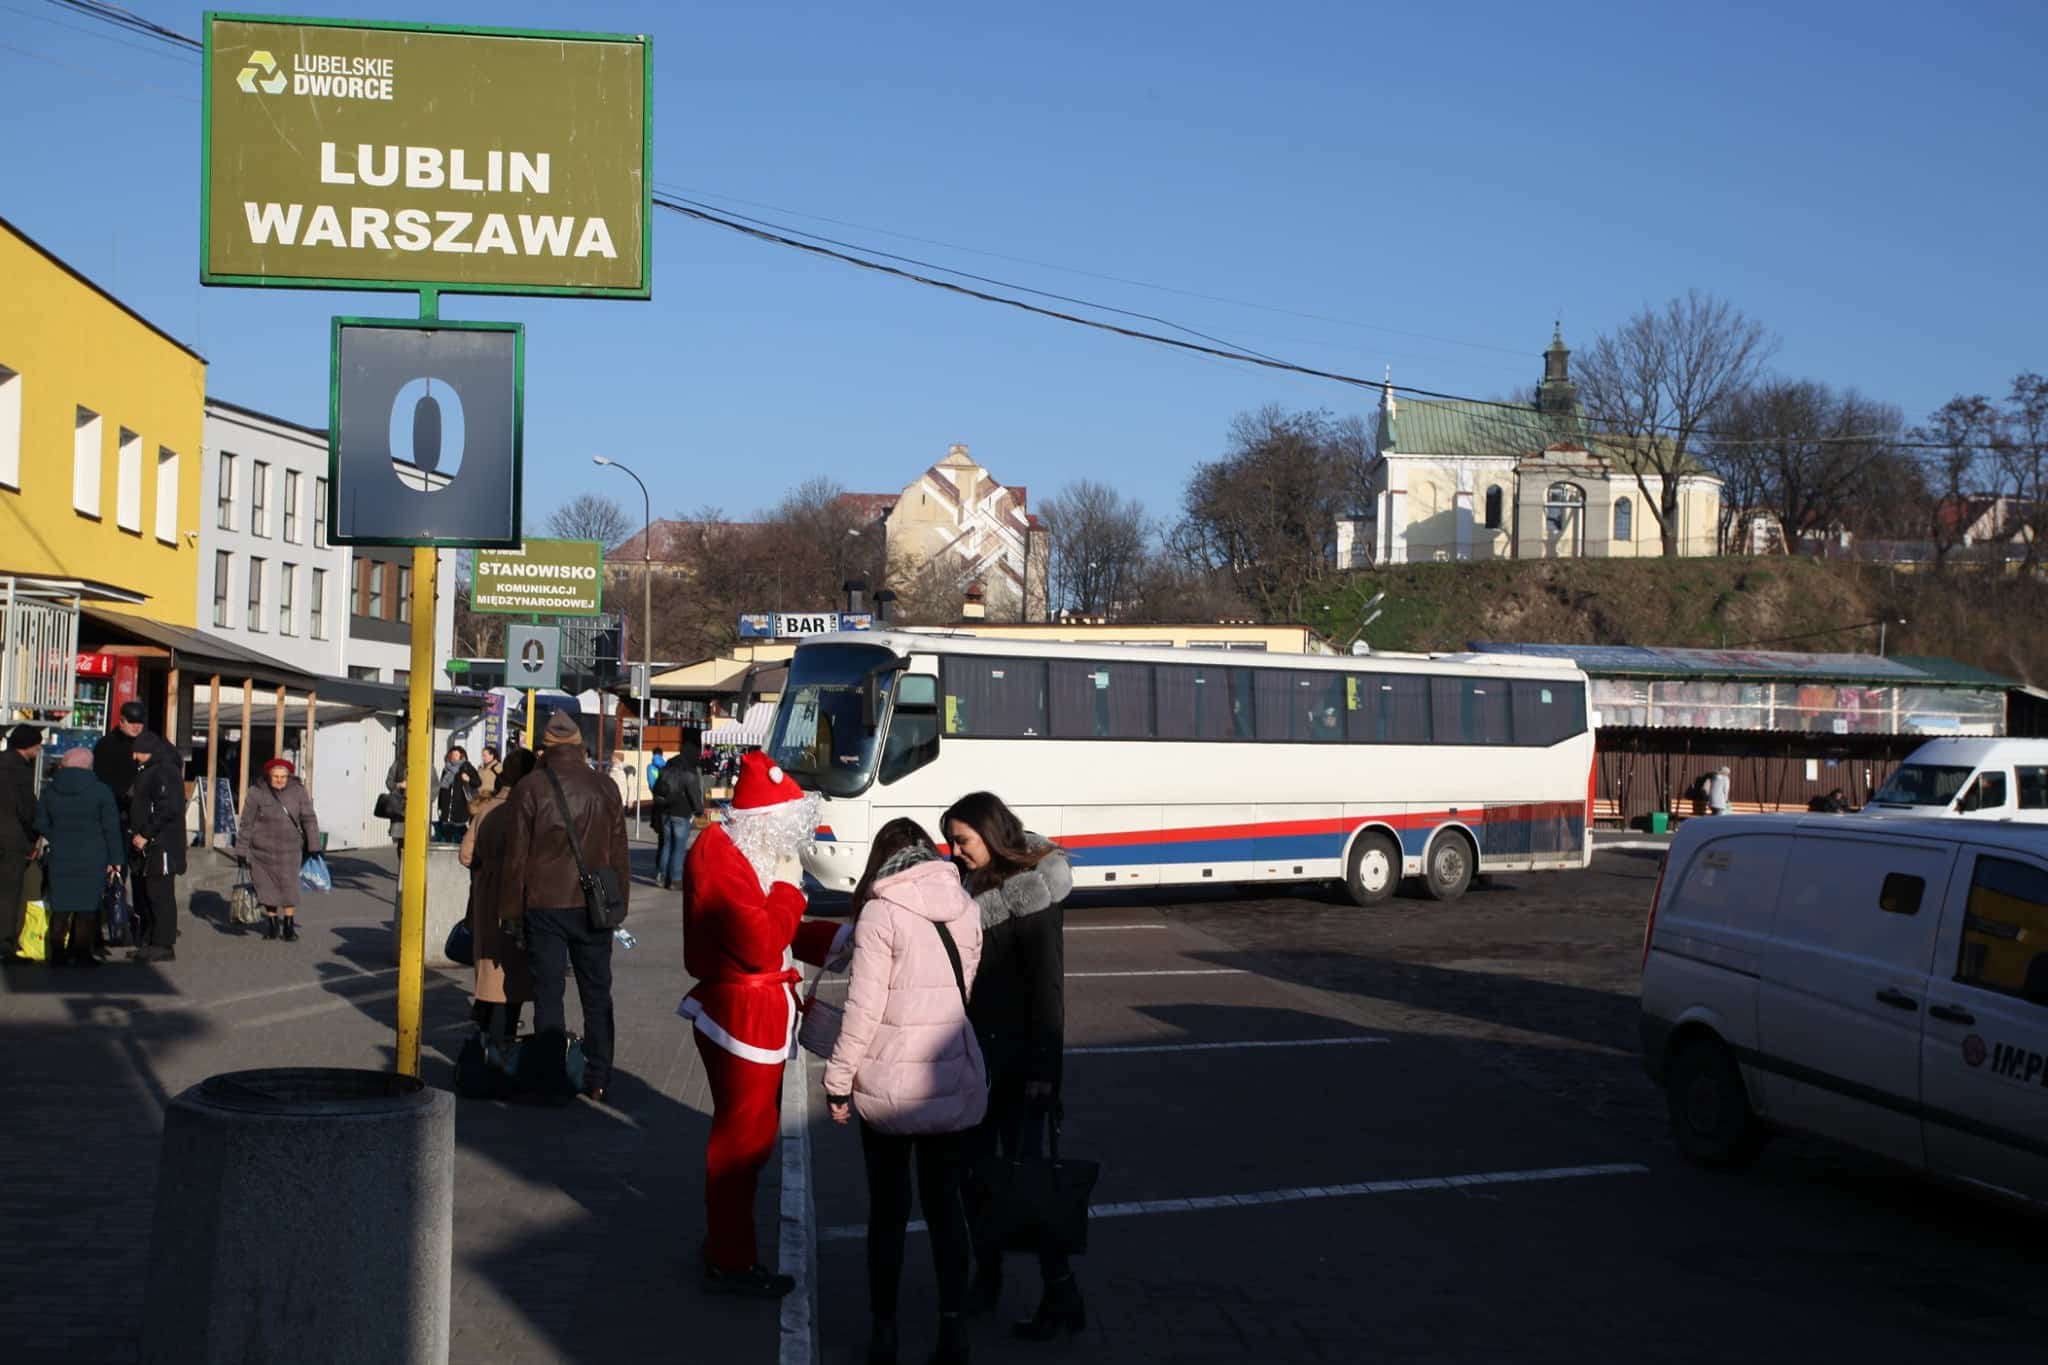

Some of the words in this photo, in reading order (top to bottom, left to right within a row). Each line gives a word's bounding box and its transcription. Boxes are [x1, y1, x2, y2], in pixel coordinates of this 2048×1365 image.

[294, 54, 393, 77] LUBELSKIE
[294, 74, 393, 100] DWORCE
[320, 141, 550, 194] LUBLIN
[244, 201, 617, 259] WARSZAWA
[389, 376, 465, 493] 0
[479, 562, 596, 579] STANOWISKO
[496, 583, 577, 595] KOMUNIKACJI
[476, 595, 595, 609] MIĘDZYNARODOWEJ
[786, 617, 825, 632] BAR
